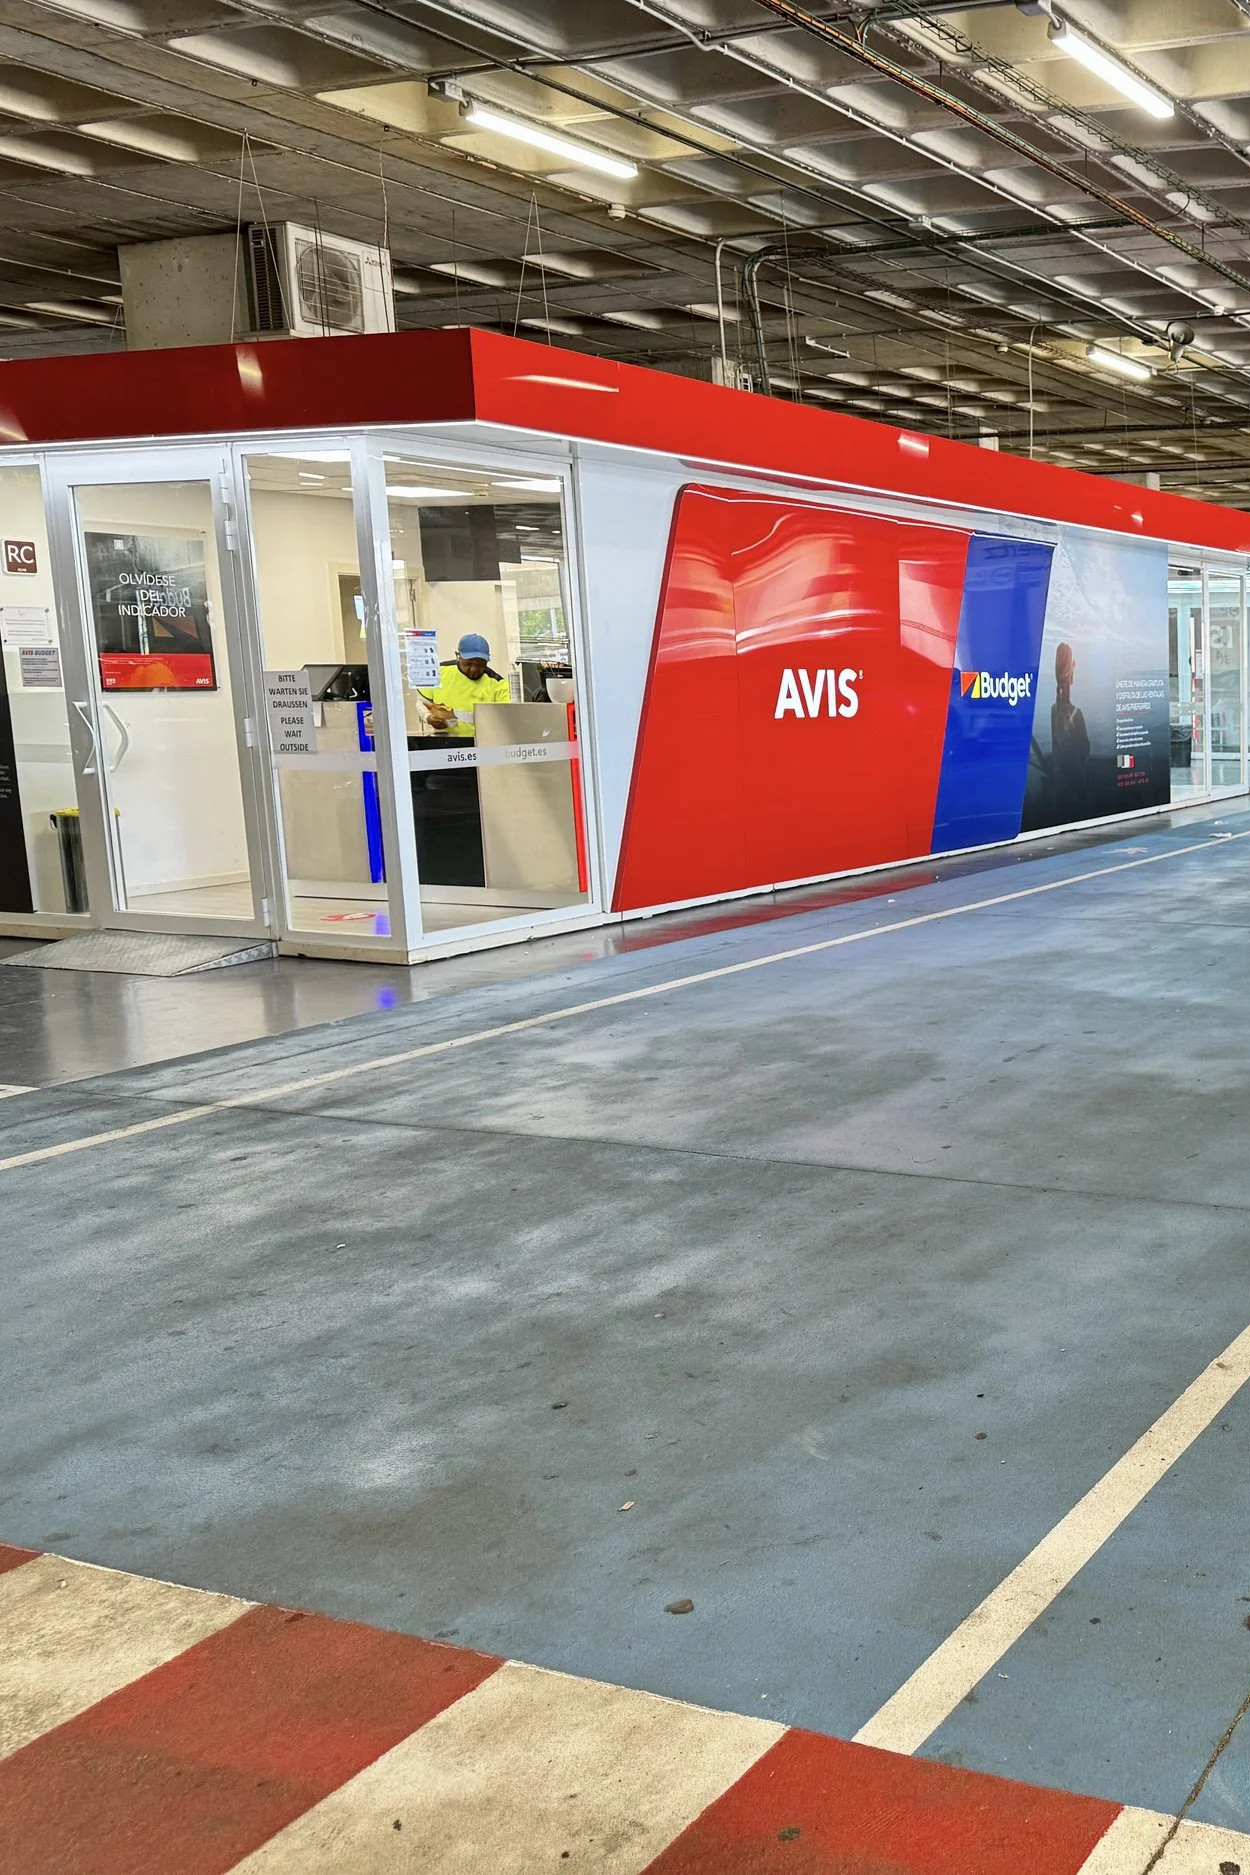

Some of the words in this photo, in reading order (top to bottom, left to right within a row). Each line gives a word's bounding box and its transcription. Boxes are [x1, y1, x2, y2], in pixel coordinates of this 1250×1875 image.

[7, 544, 34, 564] RC
[119, 571, 176, 587] OLVÍDESE
[140, 589, 163, 601] DEL
[118, 604, 186, 617] INDICADOR
[278, 674, 296, 682] BITTE
[774, 668, 860, 719] AVIS
[980, 671, 1031, 706] Budget
[280, 717, 304, 725] PLEASE
[284, 730, 302, 738] WAIT
[280, 743, 309, 751] OUTSIDE
[505, 746, 547, 760] budget.es
[447, 752, 477, 762] avis.es
